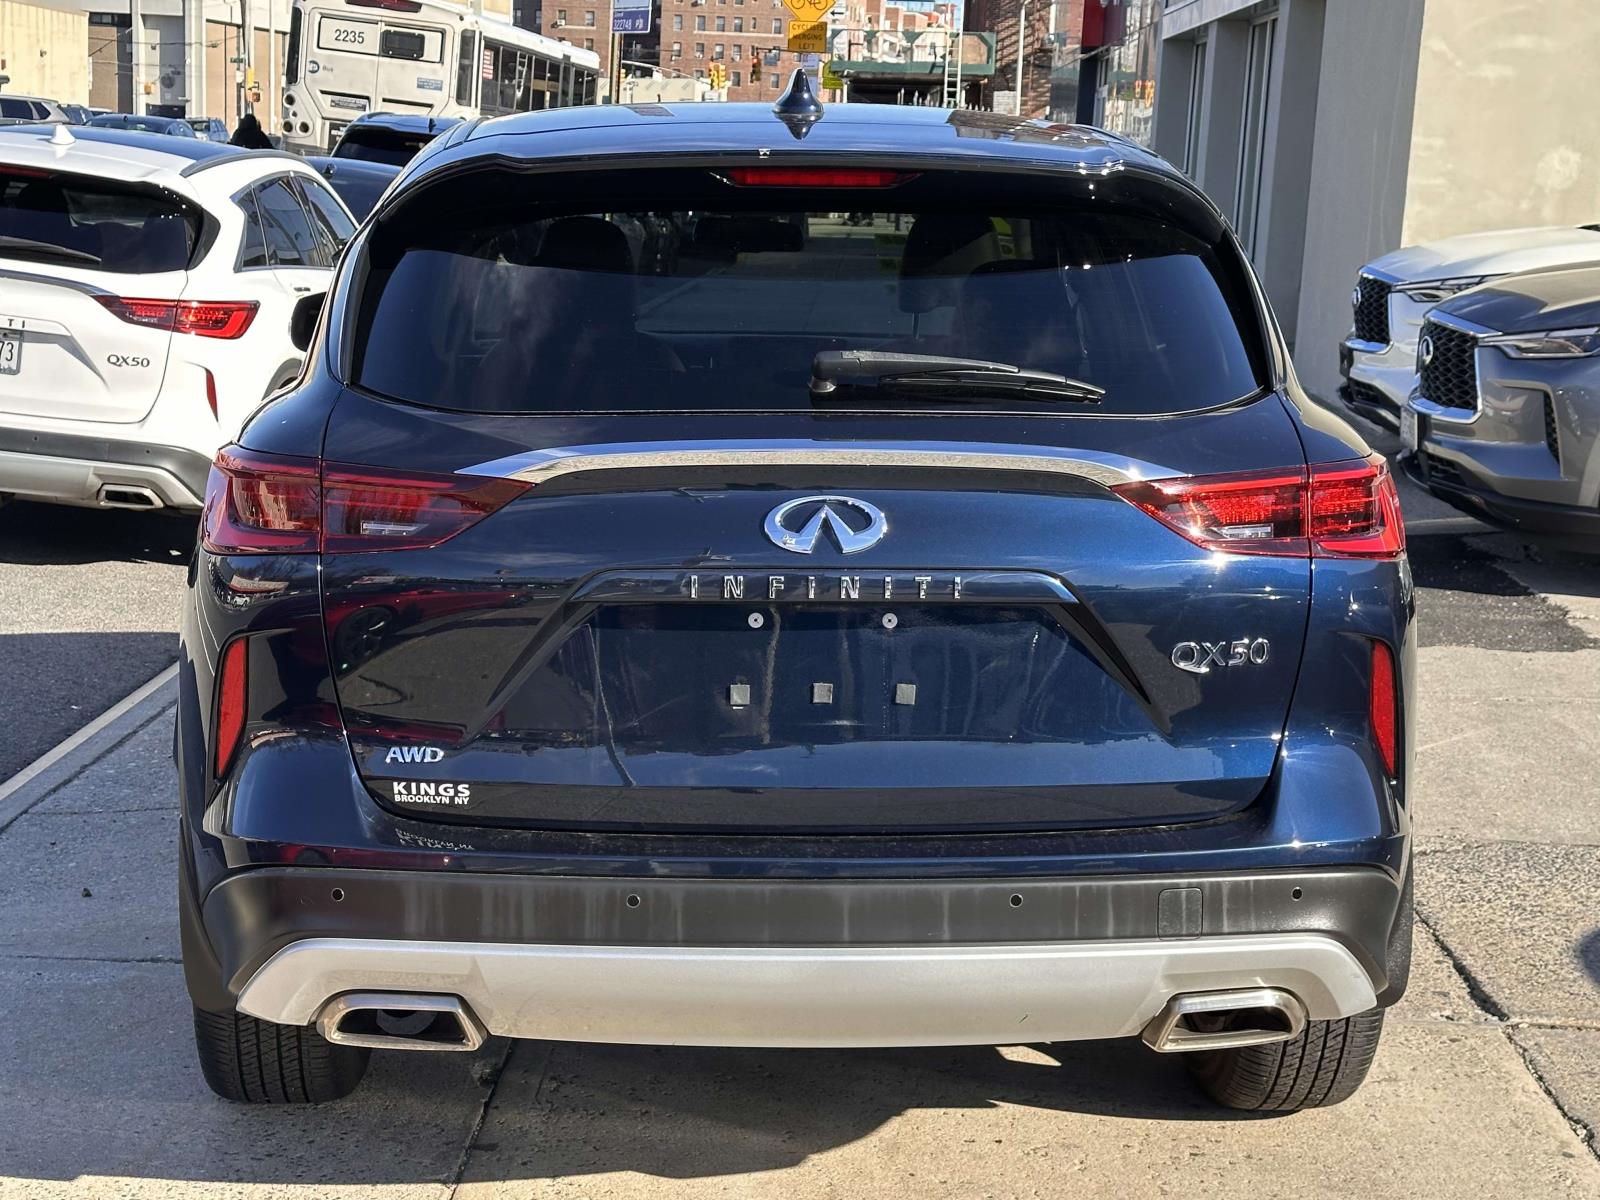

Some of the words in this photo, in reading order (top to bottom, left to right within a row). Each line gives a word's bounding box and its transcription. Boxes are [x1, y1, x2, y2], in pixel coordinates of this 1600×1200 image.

[334, 28, 365, 44] 2235
[107, 353, 150, 368] QX50
[690, 575, 961, 600] INFINITI
[1171, 637, 1270, 674] QX50
[385, 746, 445, 763] AWD
[393, 781, 471, 797] KINGS
[394, 794, 450, 804] BROOKLYN
[454, 796, 470, 805] NY
